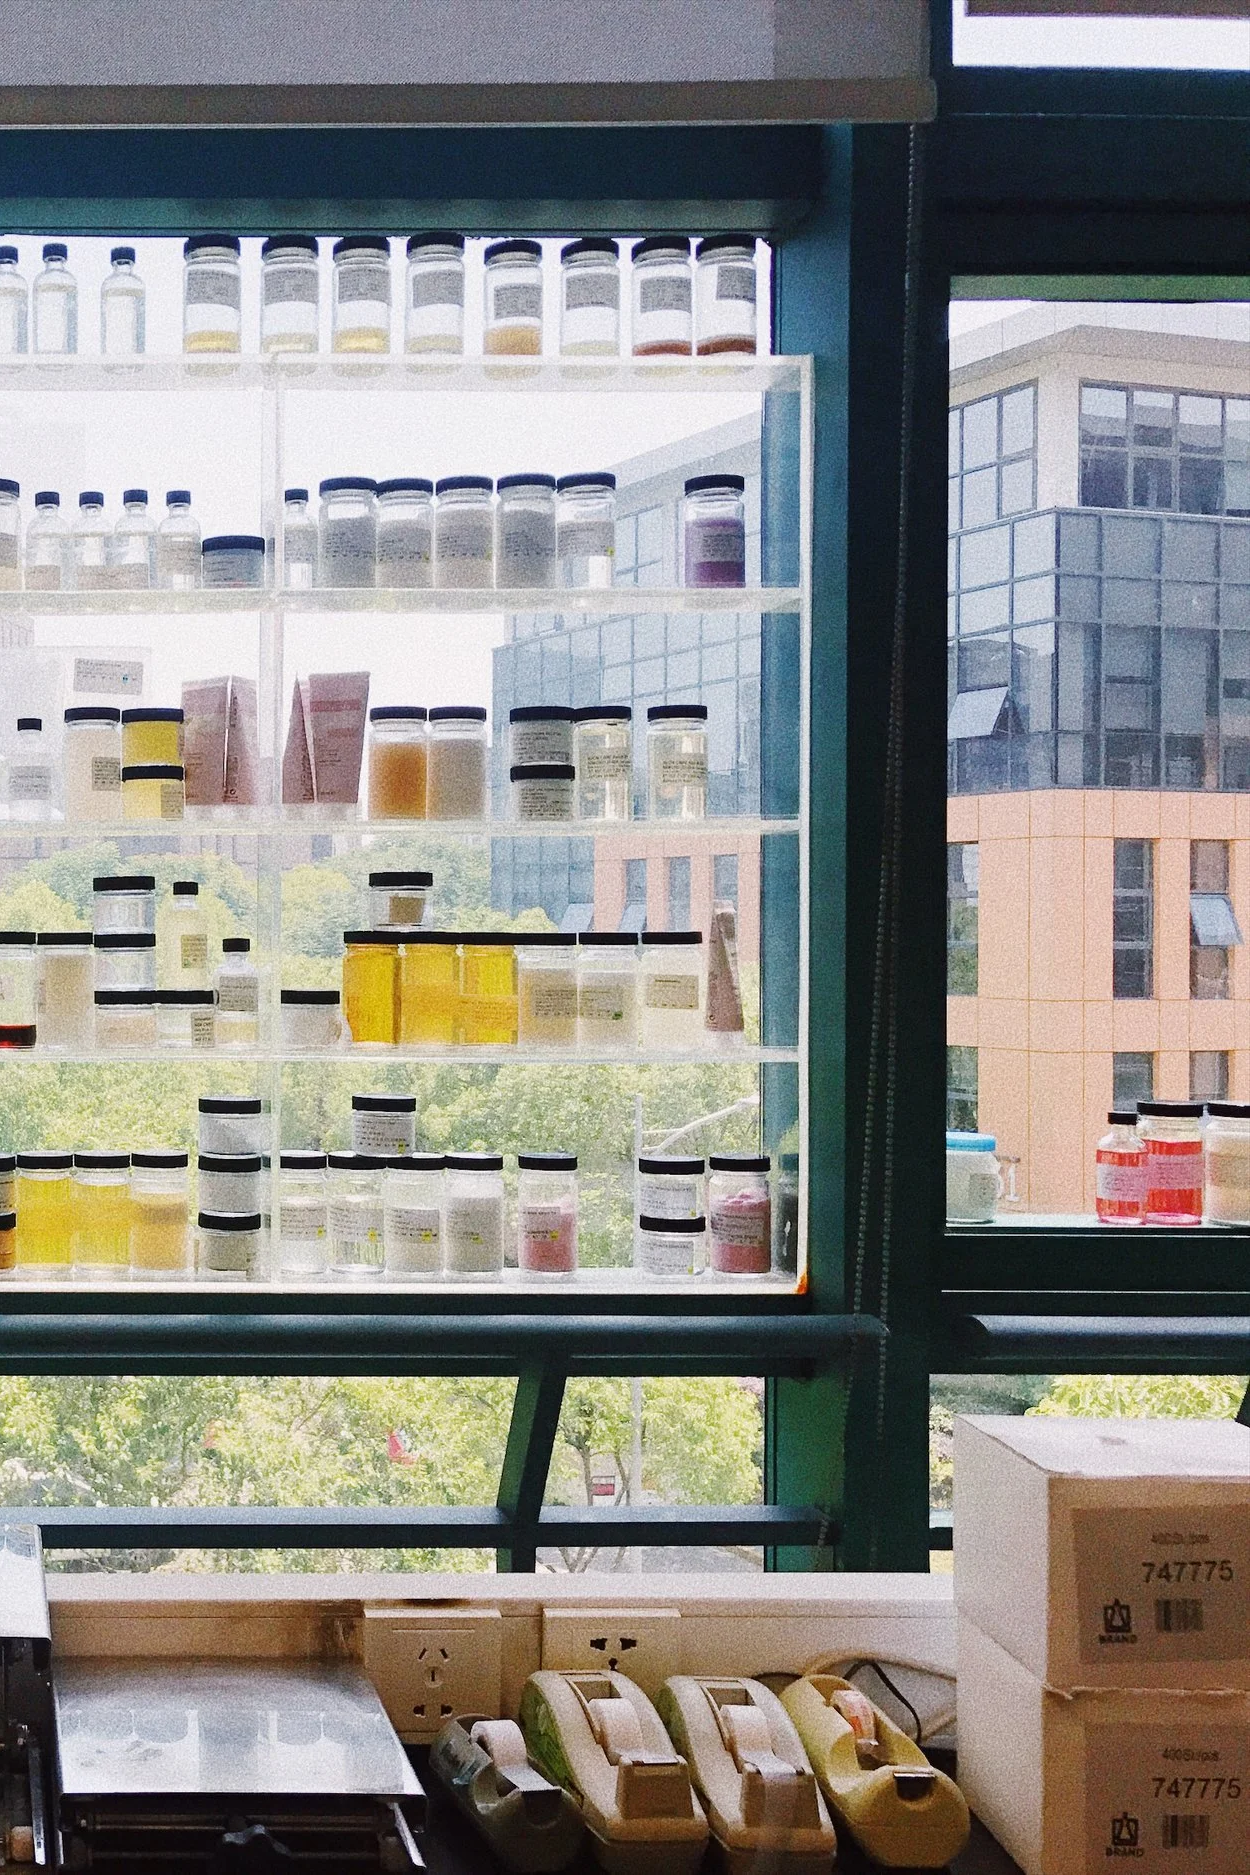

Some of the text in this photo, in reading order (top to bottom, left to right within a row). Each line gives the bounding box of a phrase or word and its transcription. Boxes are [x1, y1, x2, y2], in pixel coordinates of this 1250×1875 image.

[1141, 1560, 1235, 1584] 747775
[1098, 1634, 1139, 1645] BRAND
[1152, 1777, 1242, 1800] 747775
[1105, 1846, 1145, 1858] BRAND
